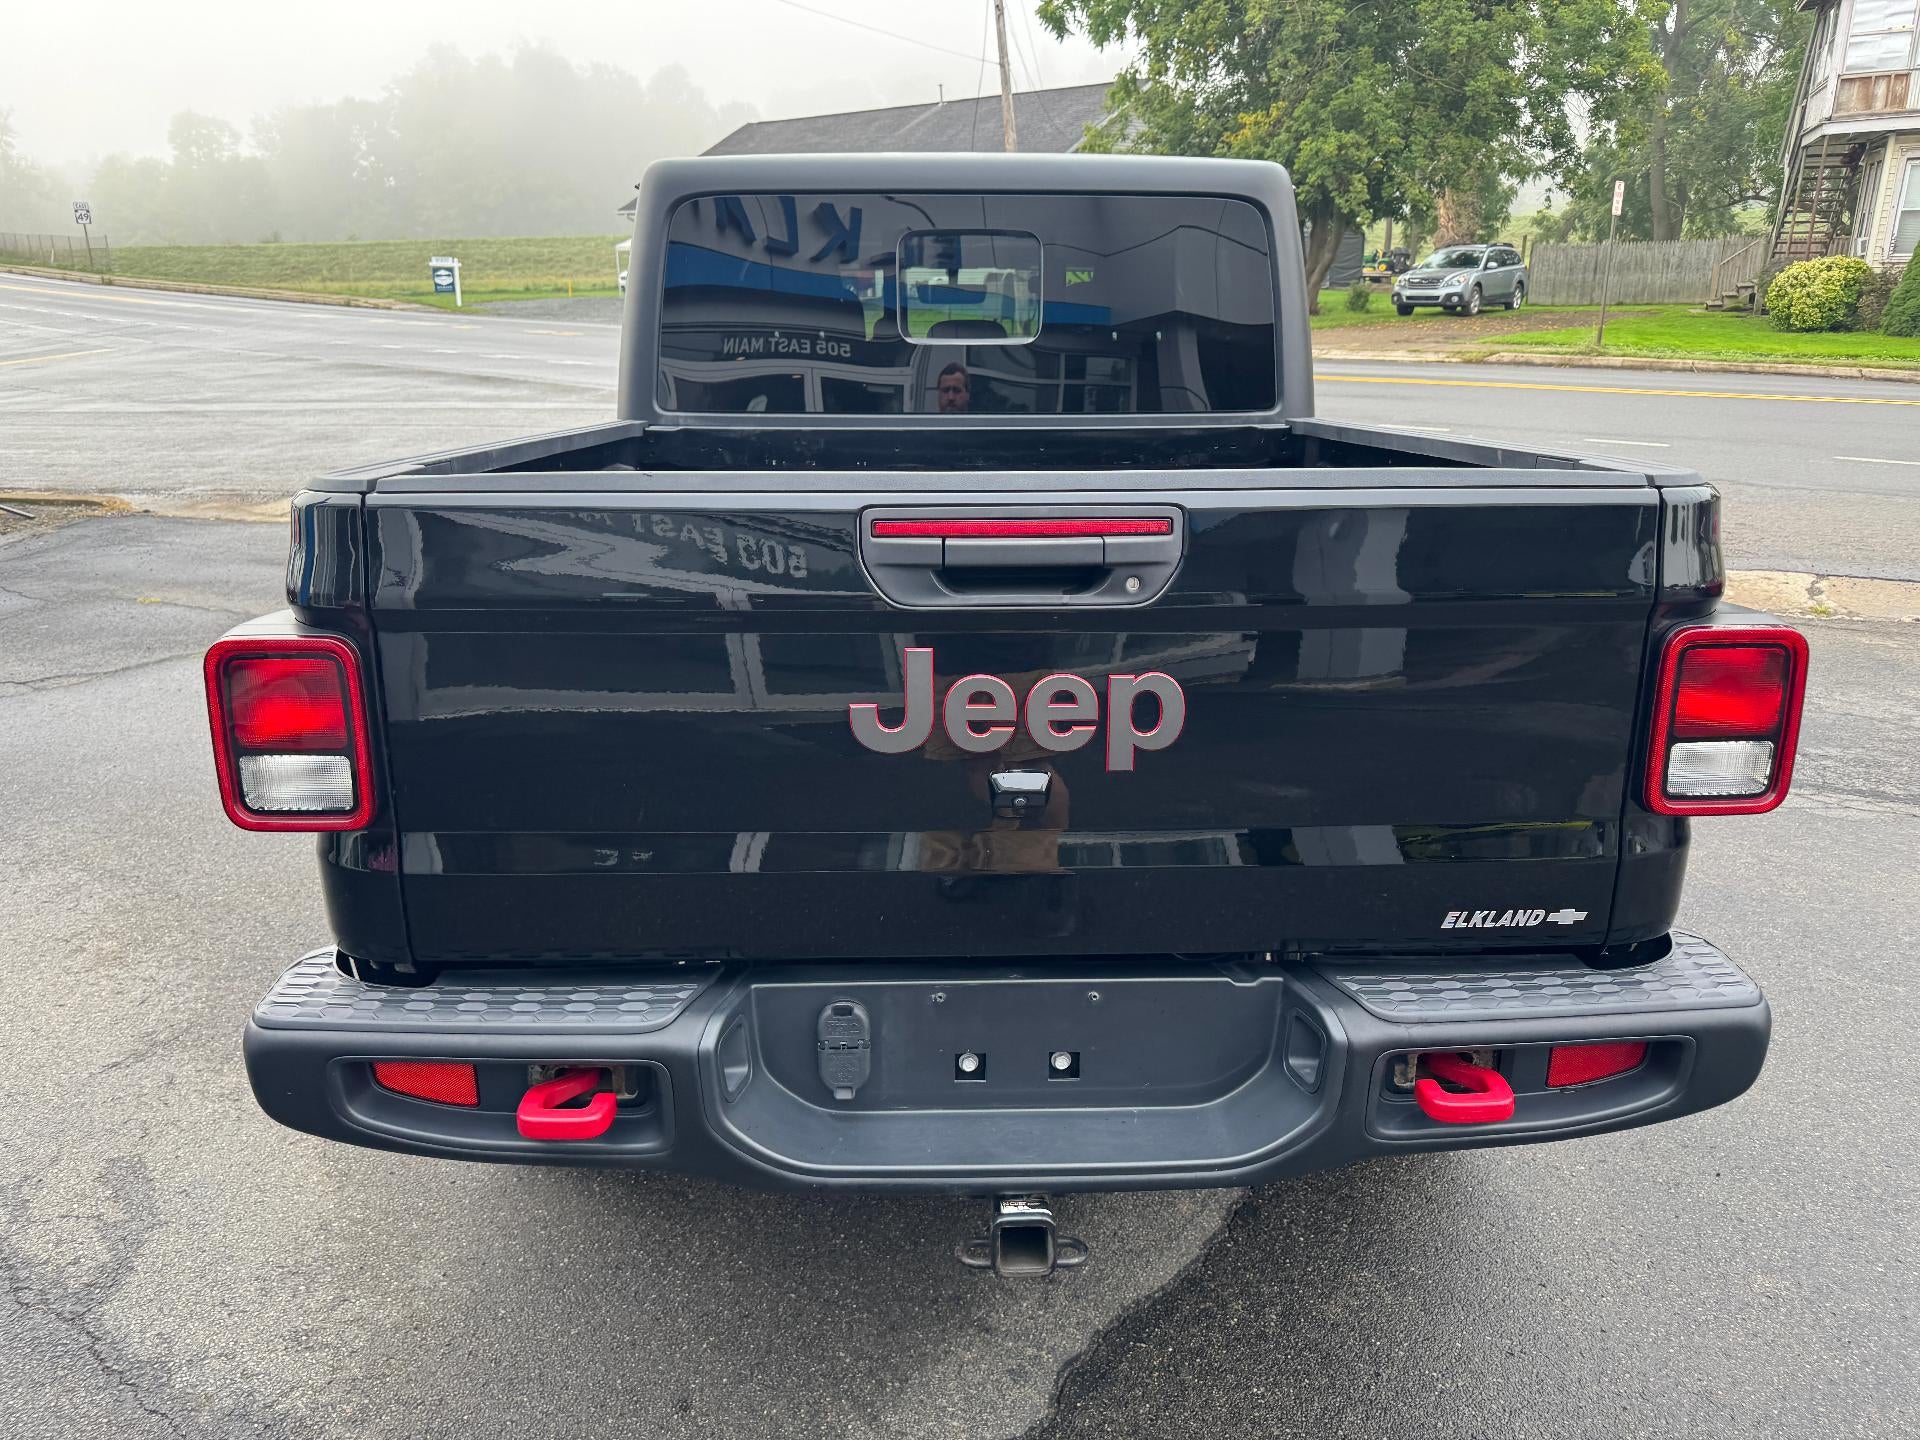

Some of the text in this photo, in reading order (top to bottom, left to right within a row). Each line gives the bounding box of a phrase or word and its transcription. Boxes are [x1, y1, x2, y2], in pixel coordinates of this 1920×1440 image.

[78, 213, 89, 221] 49
[849, 647, 1187, 772] Jeep
[1441, 909, 1546, 929] ELKLAND
